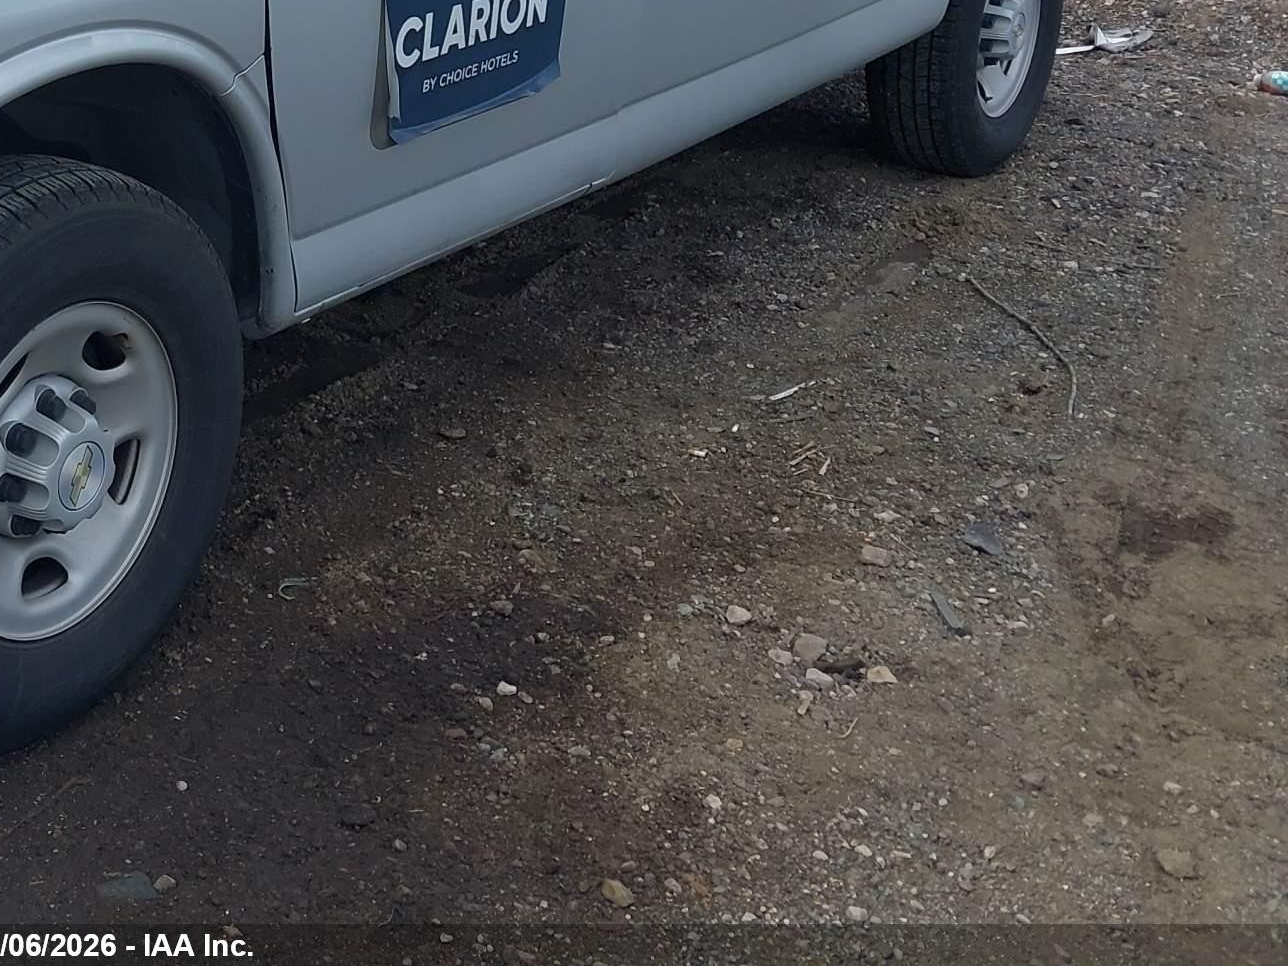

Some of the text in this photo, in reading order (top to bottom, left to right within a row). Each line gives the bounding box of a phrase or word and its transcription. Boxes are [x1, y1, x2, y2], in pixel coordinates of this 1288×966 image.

[422, 50, 519, 93] BY CHOICE HOTELS
